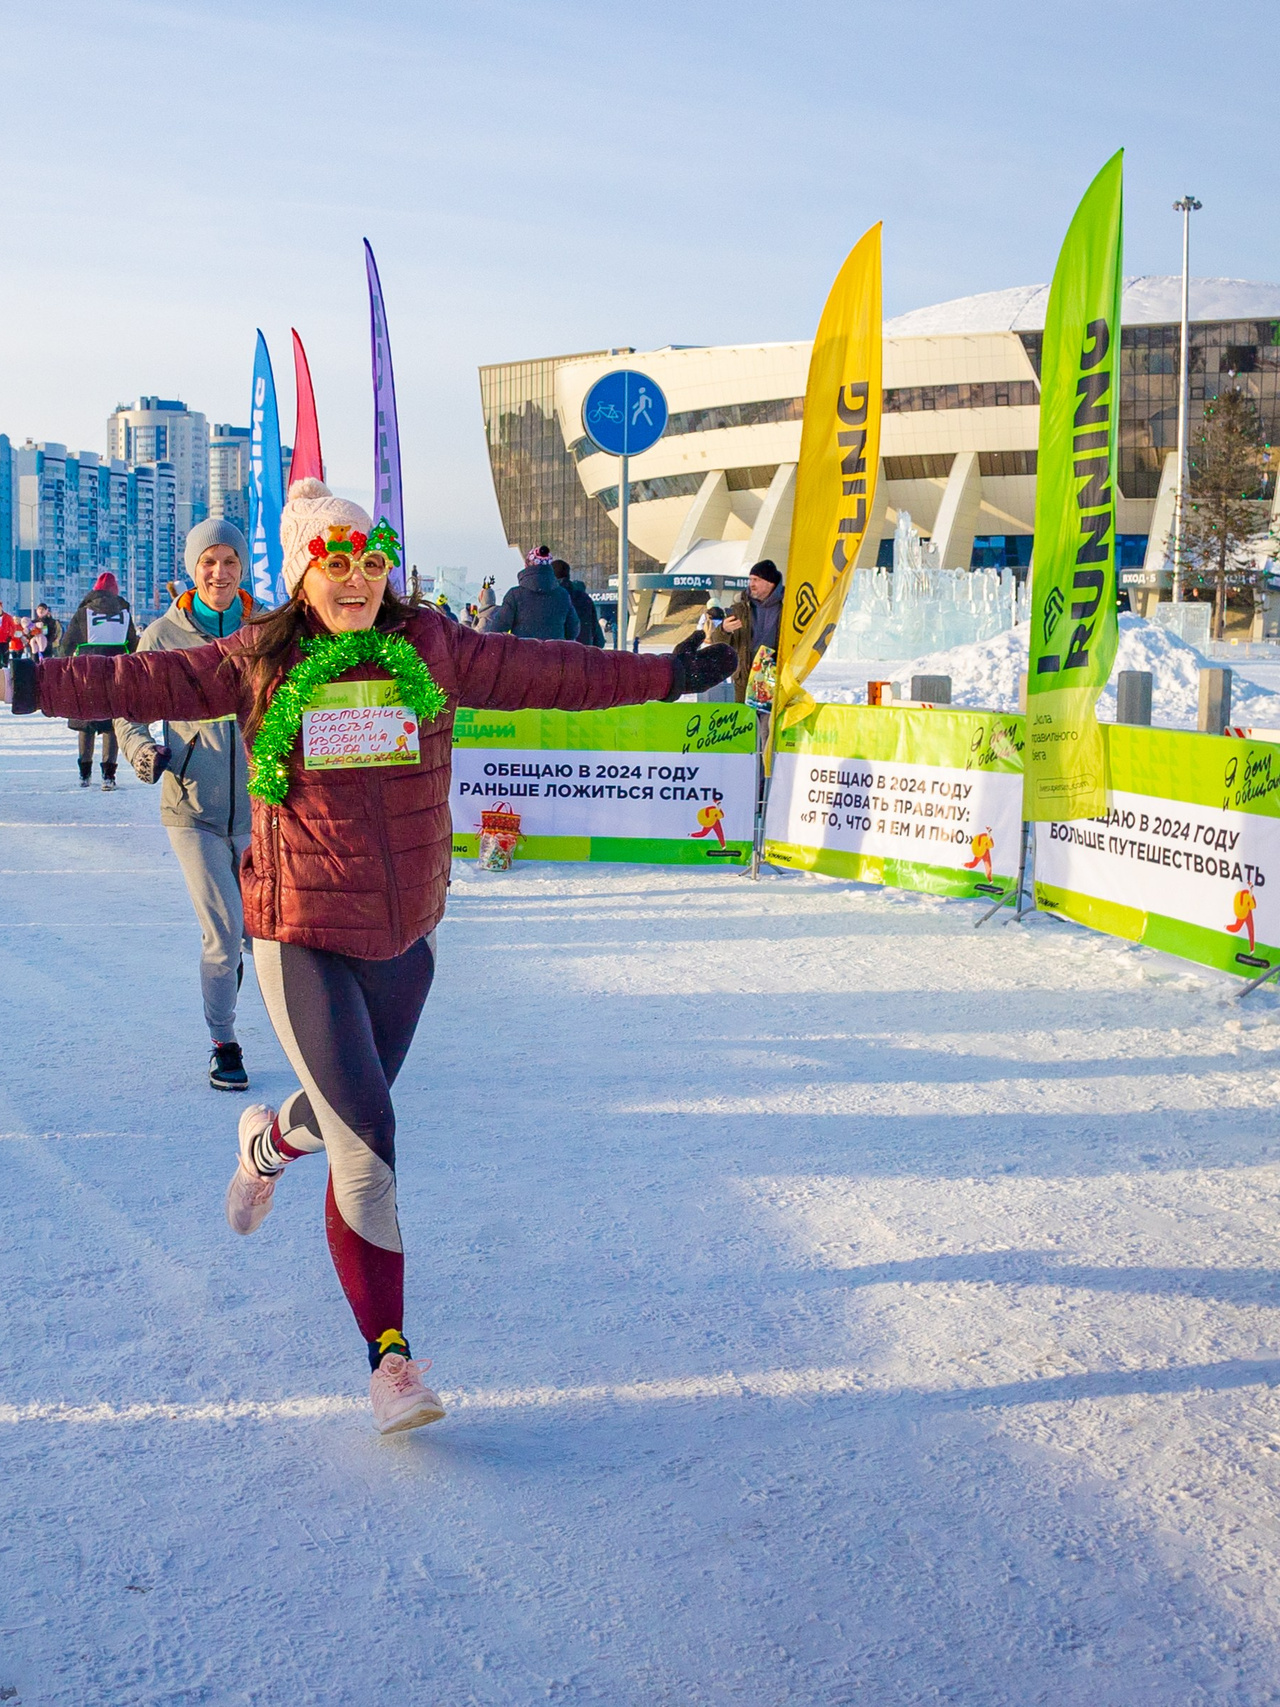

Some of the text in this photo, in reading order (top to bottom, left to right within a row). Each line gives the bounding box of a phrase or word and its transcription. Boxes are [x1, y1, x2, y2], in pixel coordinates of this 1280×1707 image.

[1063, 318, 1111, 671] RUNNING
[1037, 655, 1060, 675] I
[453, 721, 517, 741] ЕЩАНИЙ
[686, 715, 701, 737] Я
[681, 741, 691, 754] и
[483, 762, 700, 782] ОБЕЩАЮ В 2024 ГОДУ
[810, 768, 973, 799] ОБЕЩАЮ В 2024 ГОДУ
[1225, 757, 1238, 788] Я
[459, 782, 724, 801] РАНЬШЕ ЛОЖИТЬСЯ СПАТЬ
[1223, 796, 1229, 812] и
[808, 790, 970, 822] СЛЕДОВАТЬ ПРАВИЛУ:
[800, 811, 974, 845] «Я ТО, ЧТО Я ЕМ И ПЬЮ»
[1140, 813, 1149, 832] В
[1152, 816, 1190, 841] 2024
[1194, 824, 1241, 852] ГОДУ
[1049, 822, 1266, 888] БОЛЬШЕ ПУТЕШЕСТВОВАТЬ
